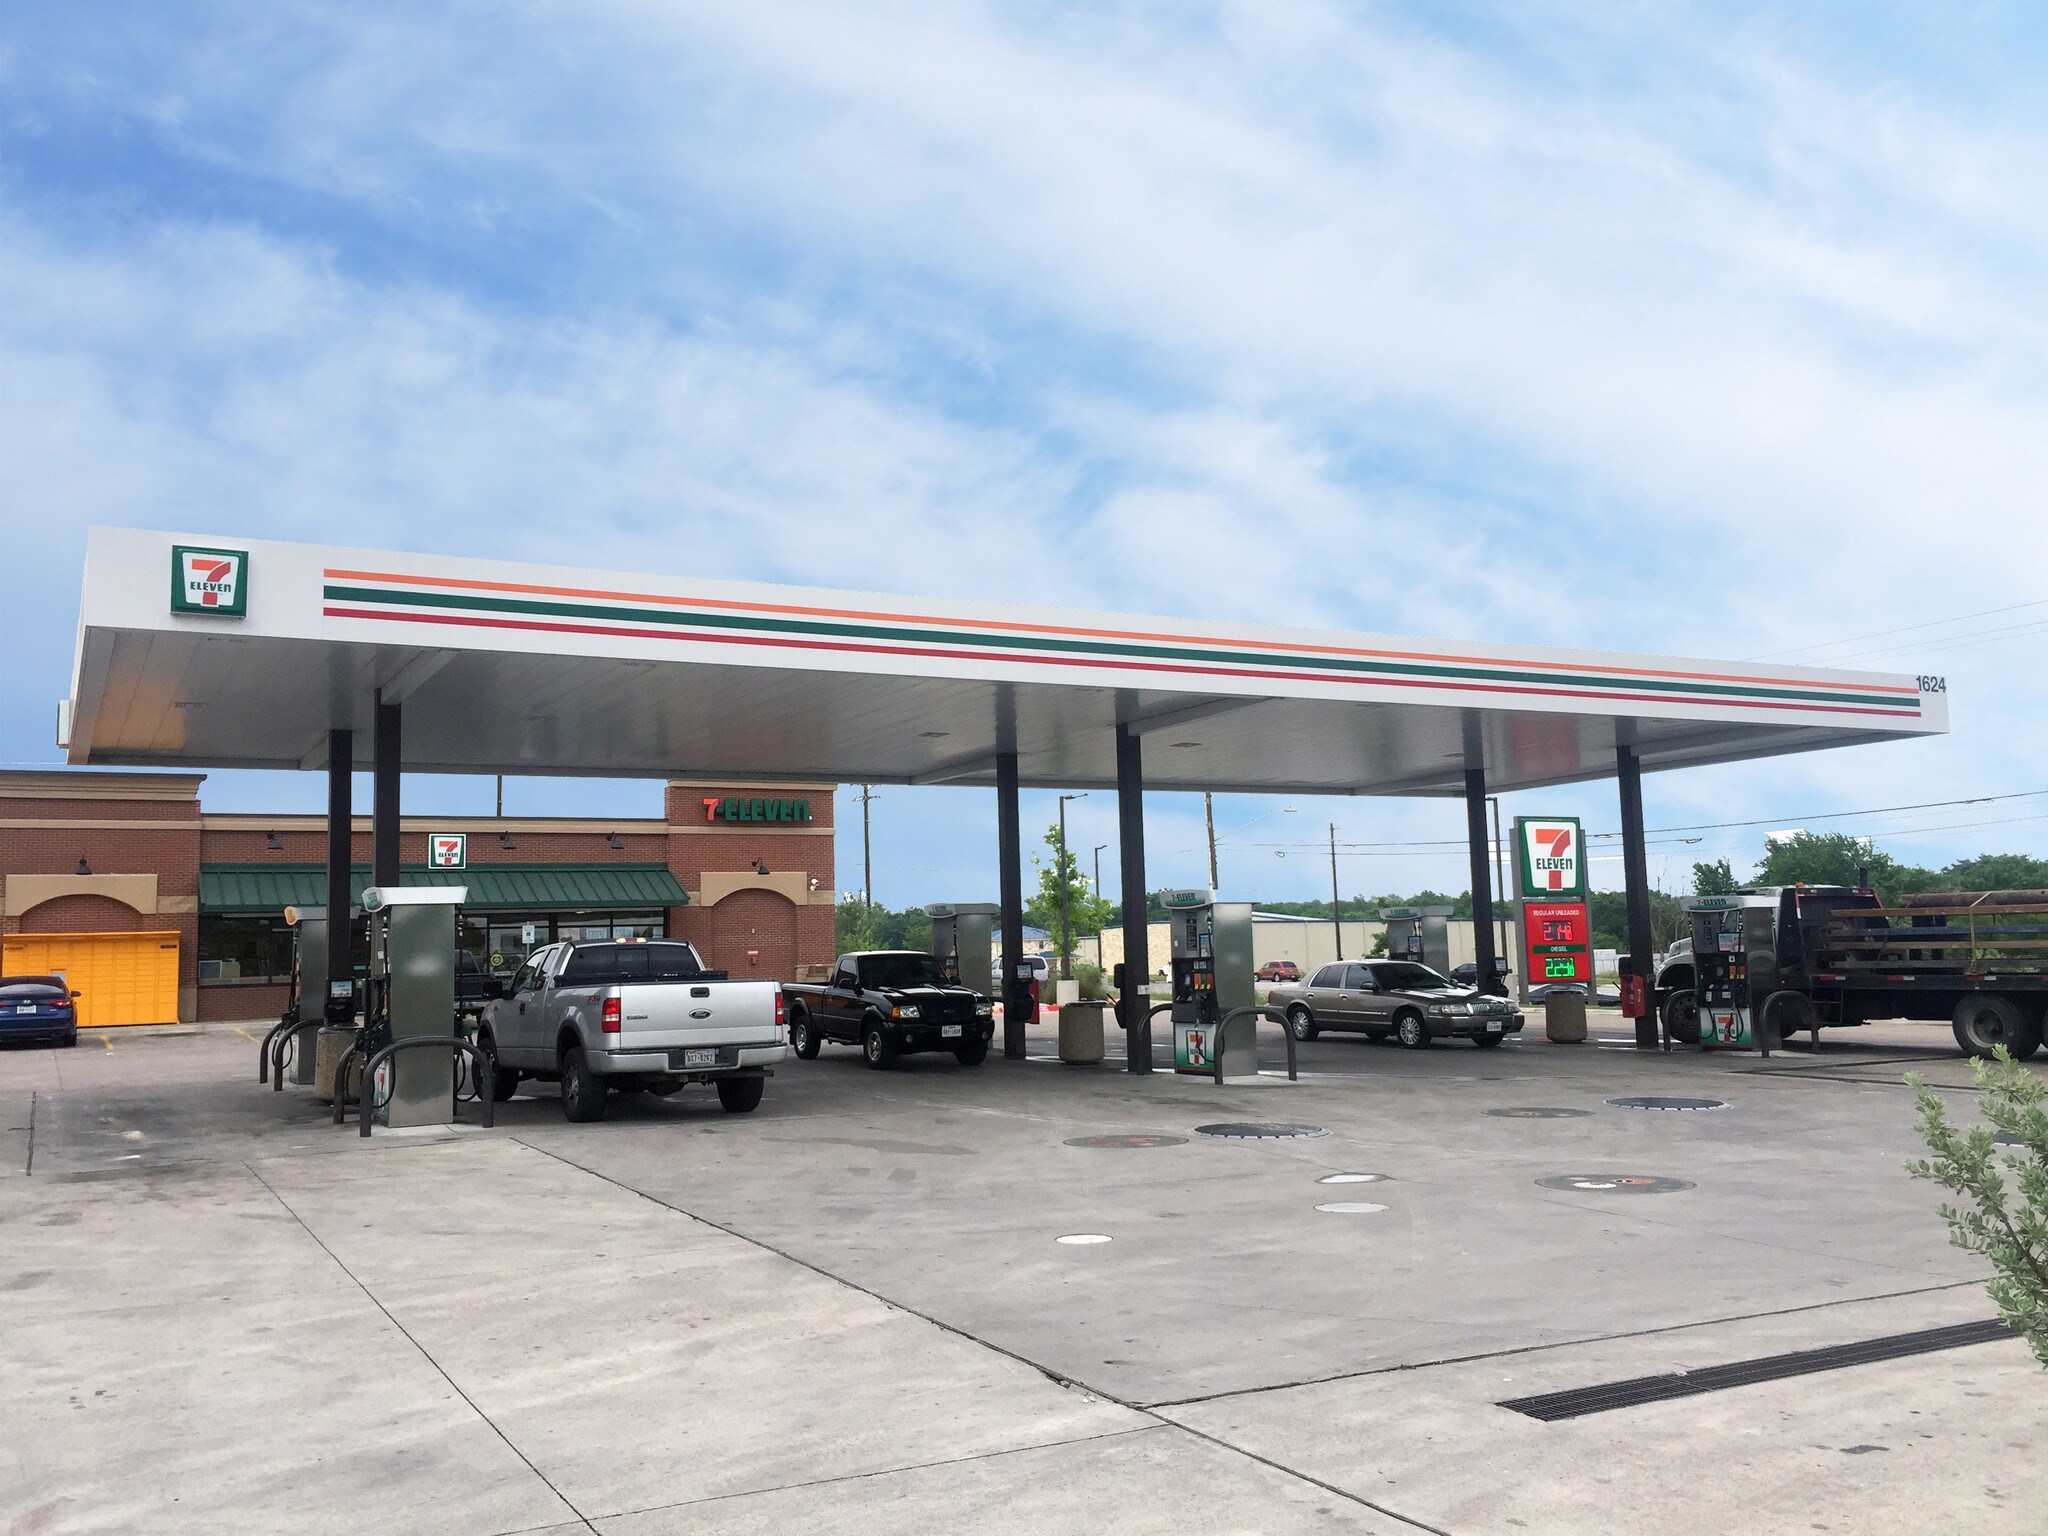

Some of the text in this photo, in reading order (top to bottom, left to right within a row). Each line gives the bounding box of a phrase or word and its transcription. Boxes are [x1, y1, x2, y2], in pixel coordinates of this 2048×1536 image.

[191, 558, 231, 605] 7
[1915, 675, 1946, 693] 1624
[1535, 829, 1570, 889] 7
